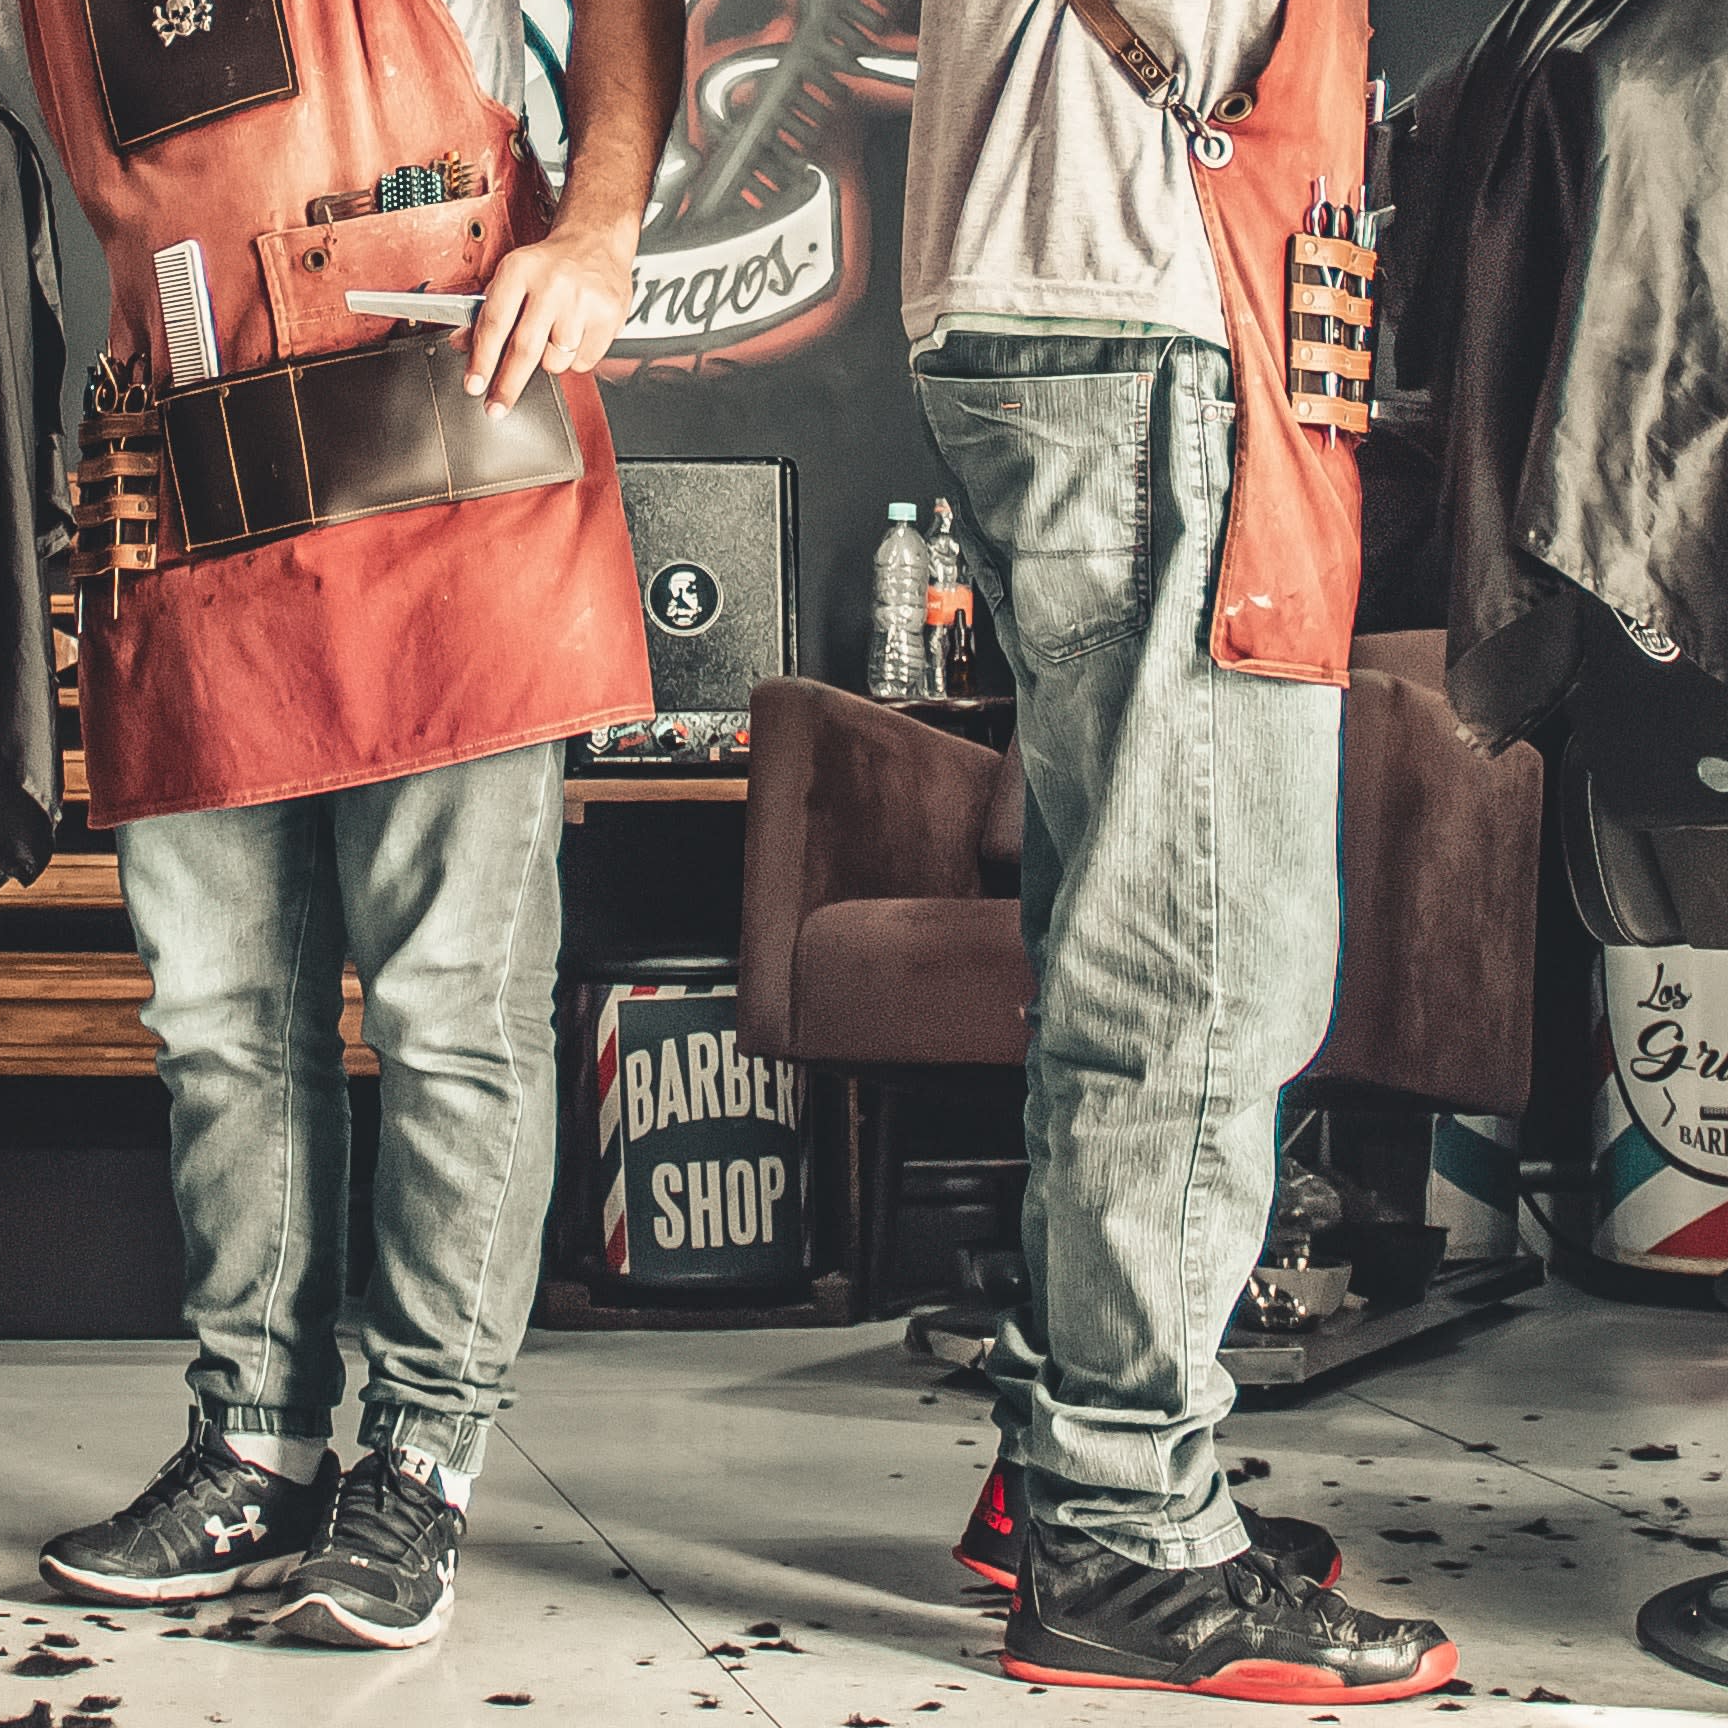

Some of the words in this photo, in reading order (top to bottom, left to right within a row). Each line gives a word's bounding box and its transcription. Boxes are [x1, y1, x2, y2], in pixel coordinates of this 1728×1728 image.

[1637, 961, 1692, 1012] Los
[625, 1030, 796, 1142] BARBER
[651, 1156, 786, 1251] SHOP
